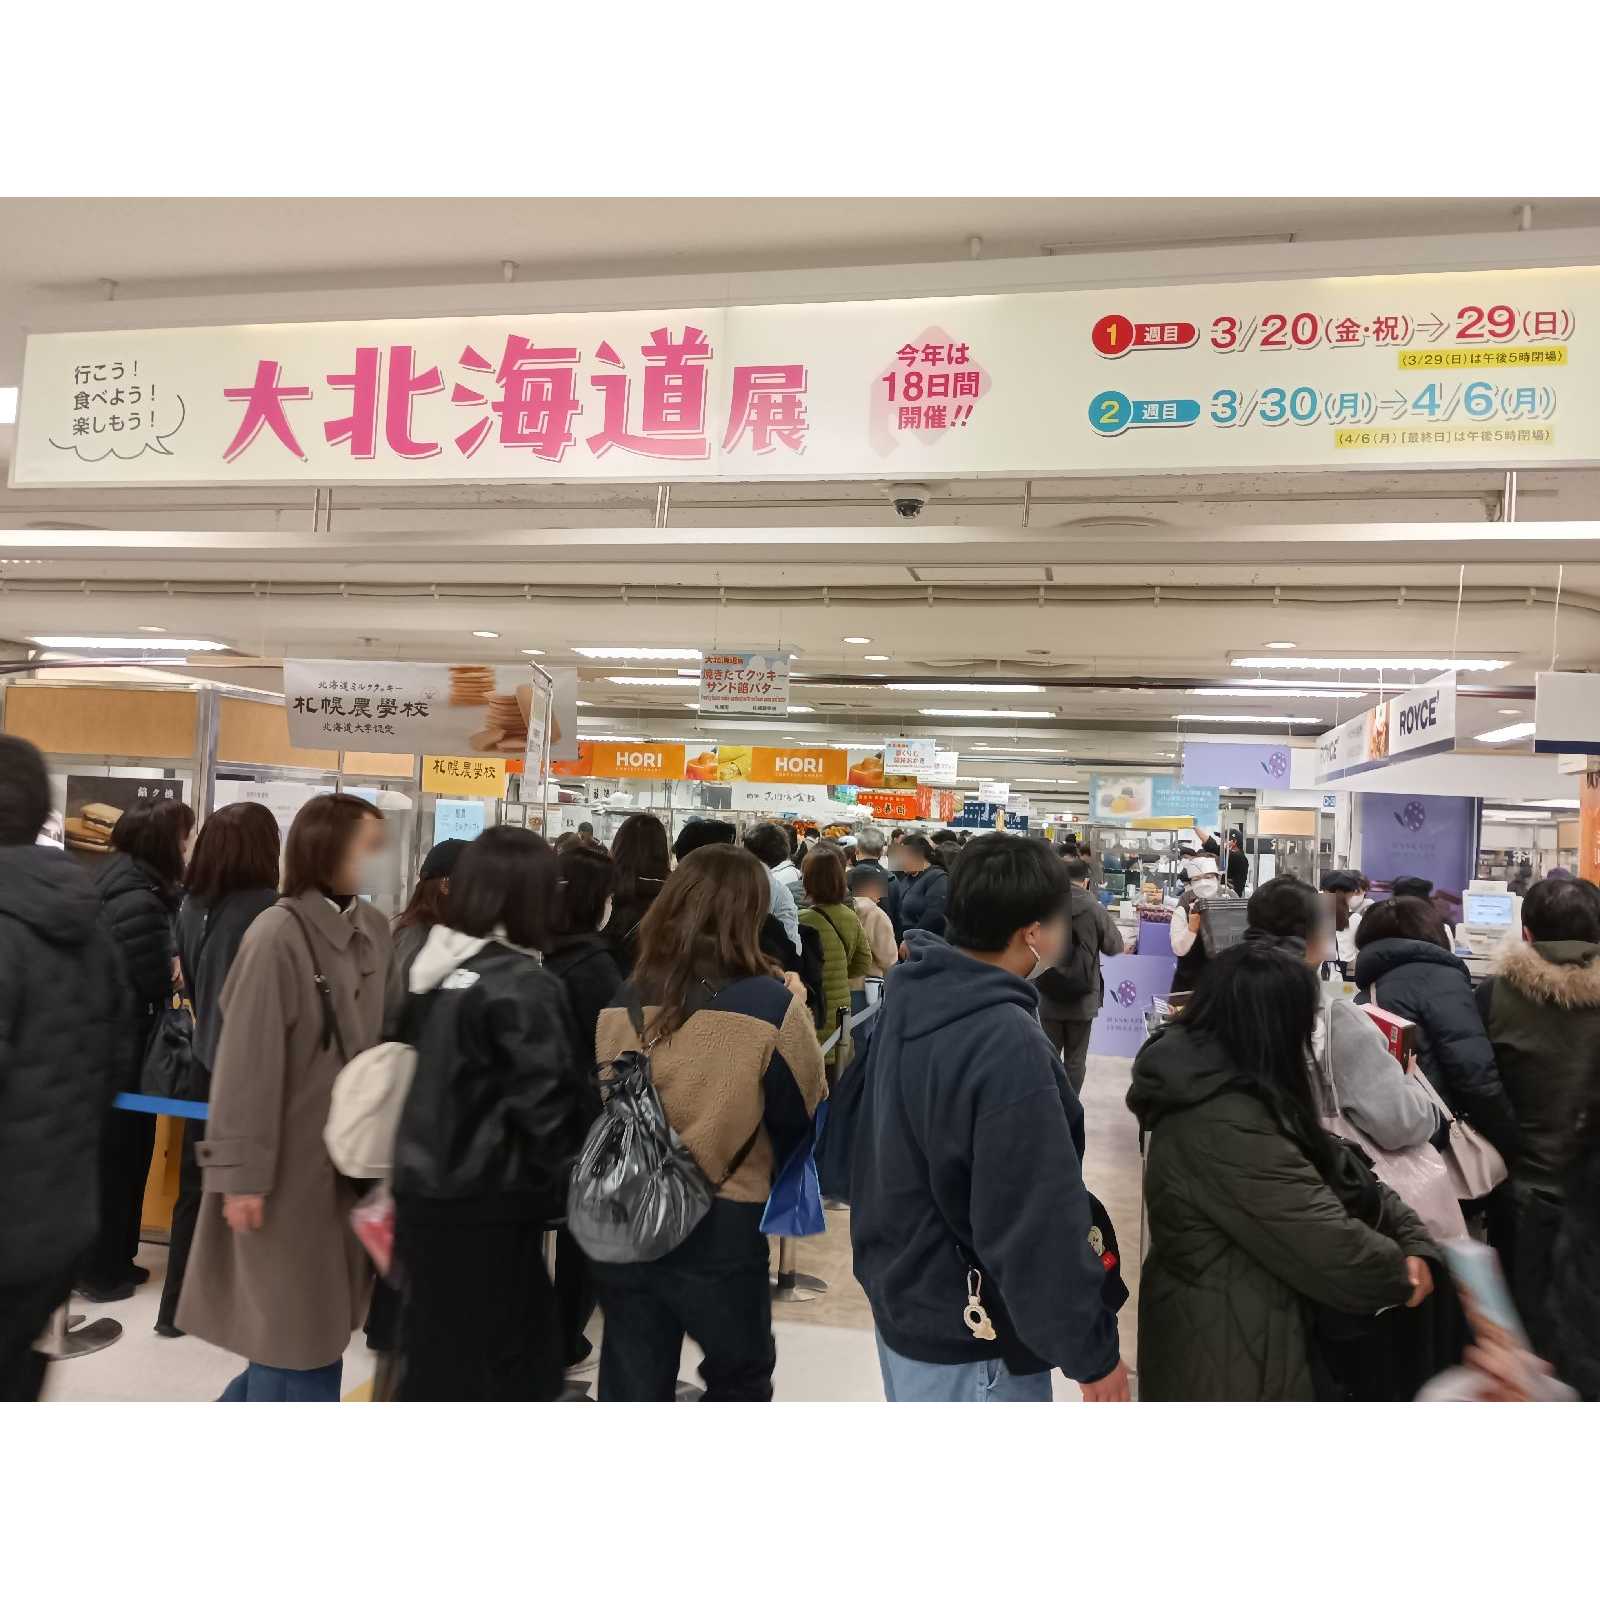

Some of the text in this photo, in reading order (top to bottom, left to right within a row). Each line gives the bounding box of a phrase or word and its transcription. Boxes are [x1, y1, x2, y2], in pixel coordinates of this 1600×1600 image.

[1107, 323, 1117, 345] 1
[896, 343, 970, 367] 今年は
[74, 360, 138, 384] 行こう！
[73, 384, 155, 411] 食べよう！
[222, 325, 809, 464] 大北海道展
[882, 371, 980, 401] 18日間
[73, 410, 155, 436] 楽しもう！
[898, 404, 974, 430] 開催!!
[1100, 400, 1120, 423] 2
[703, 669, 787, 681] 焼きたてクッキー
[293, 695, 430, 719] 札幌農學校
[616, 751, 663, 768] HORI
[775, 757, 823, 773] HORI
